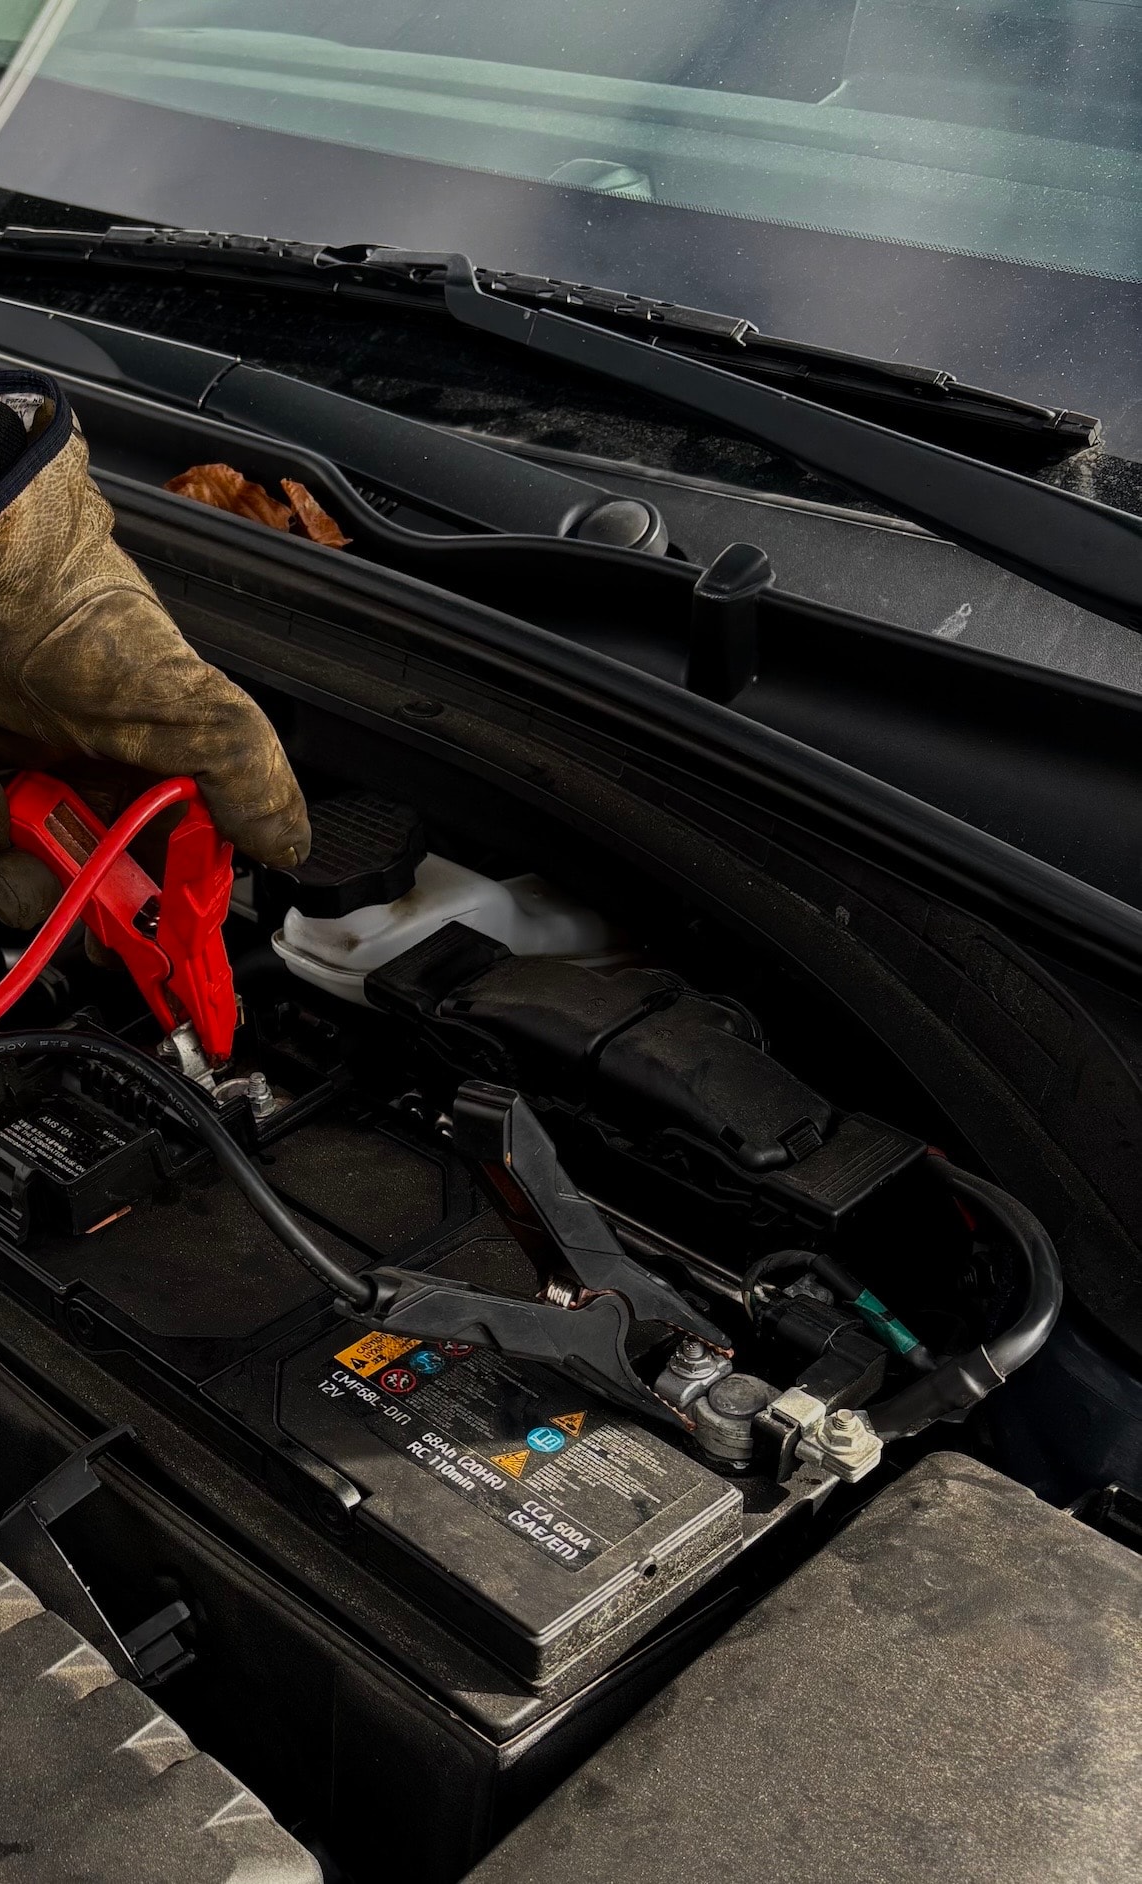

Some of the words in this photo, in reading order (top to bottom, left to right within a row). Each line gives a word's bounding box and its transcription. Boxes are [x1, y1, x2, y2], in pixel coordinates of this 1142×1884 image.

[167, 1092, 199, 1128] NOCO
[317, 1379, 346, 1398] 12V
[331, 1370, 412, 1426] CMF68L-DIN
[406, 1440, 431, 1459] RC
[428, 1455, 476, 1491] 110min
[421, 1431, 458, 1459] 68Ah
[456, 1455, 507, 1491] (20HR)
[507, 1510, 579, 1560] (SAE/EN)
[522, 1500, 554, 1525] CCA
[552, 1521, 592, 1551] 600A
